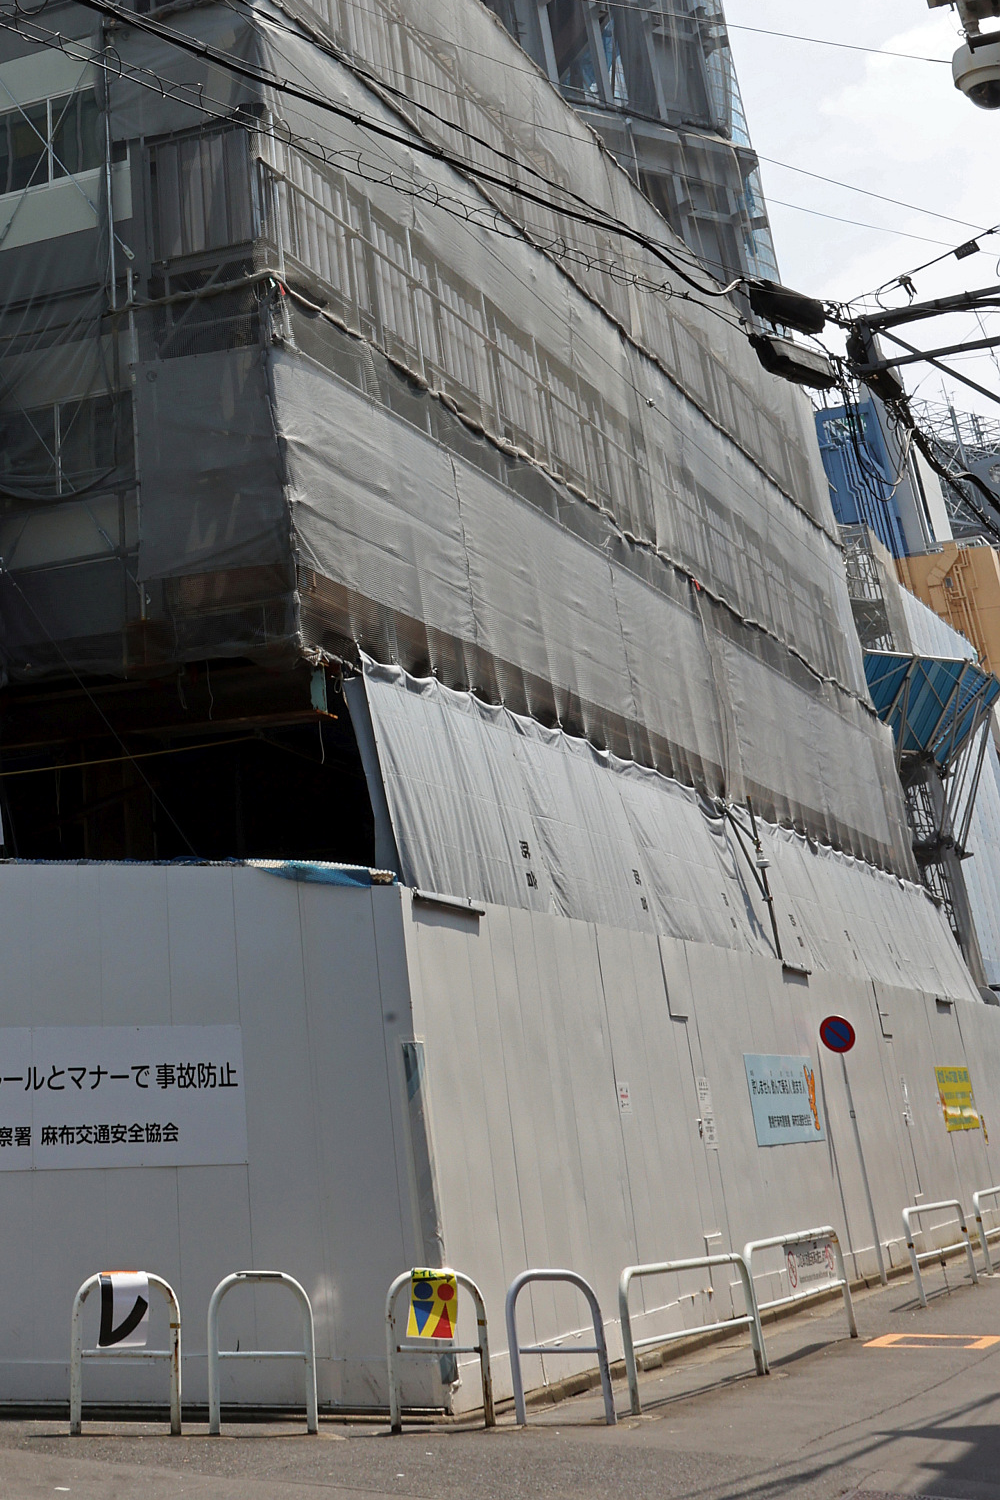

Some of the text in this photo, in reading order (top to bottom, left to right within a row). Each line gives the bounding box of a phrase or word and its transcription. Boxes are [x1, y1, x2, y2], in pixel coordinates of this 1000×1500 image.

[40, 1121, 180, 1147] 麻布交通安全協会
